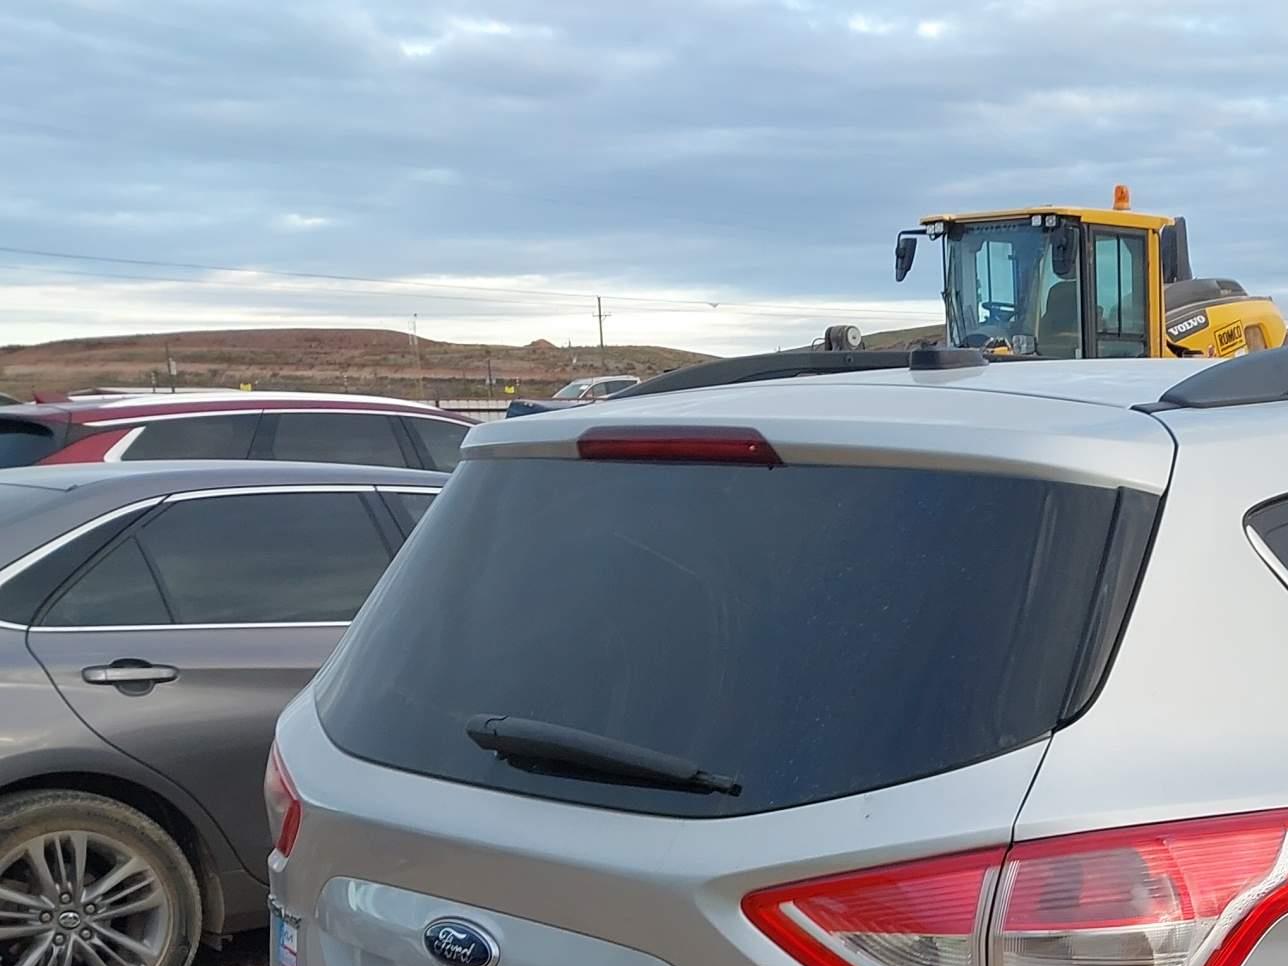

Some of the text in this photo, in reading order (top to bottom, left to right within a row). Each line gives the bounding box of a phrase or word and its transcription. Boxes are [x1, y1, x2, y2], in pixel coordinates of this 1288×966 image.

[1167, 314, 1206, 336] VOLVO
[1218, 324, 1243, 347] ROMCO
[433, 926, 476, 964] Ford
